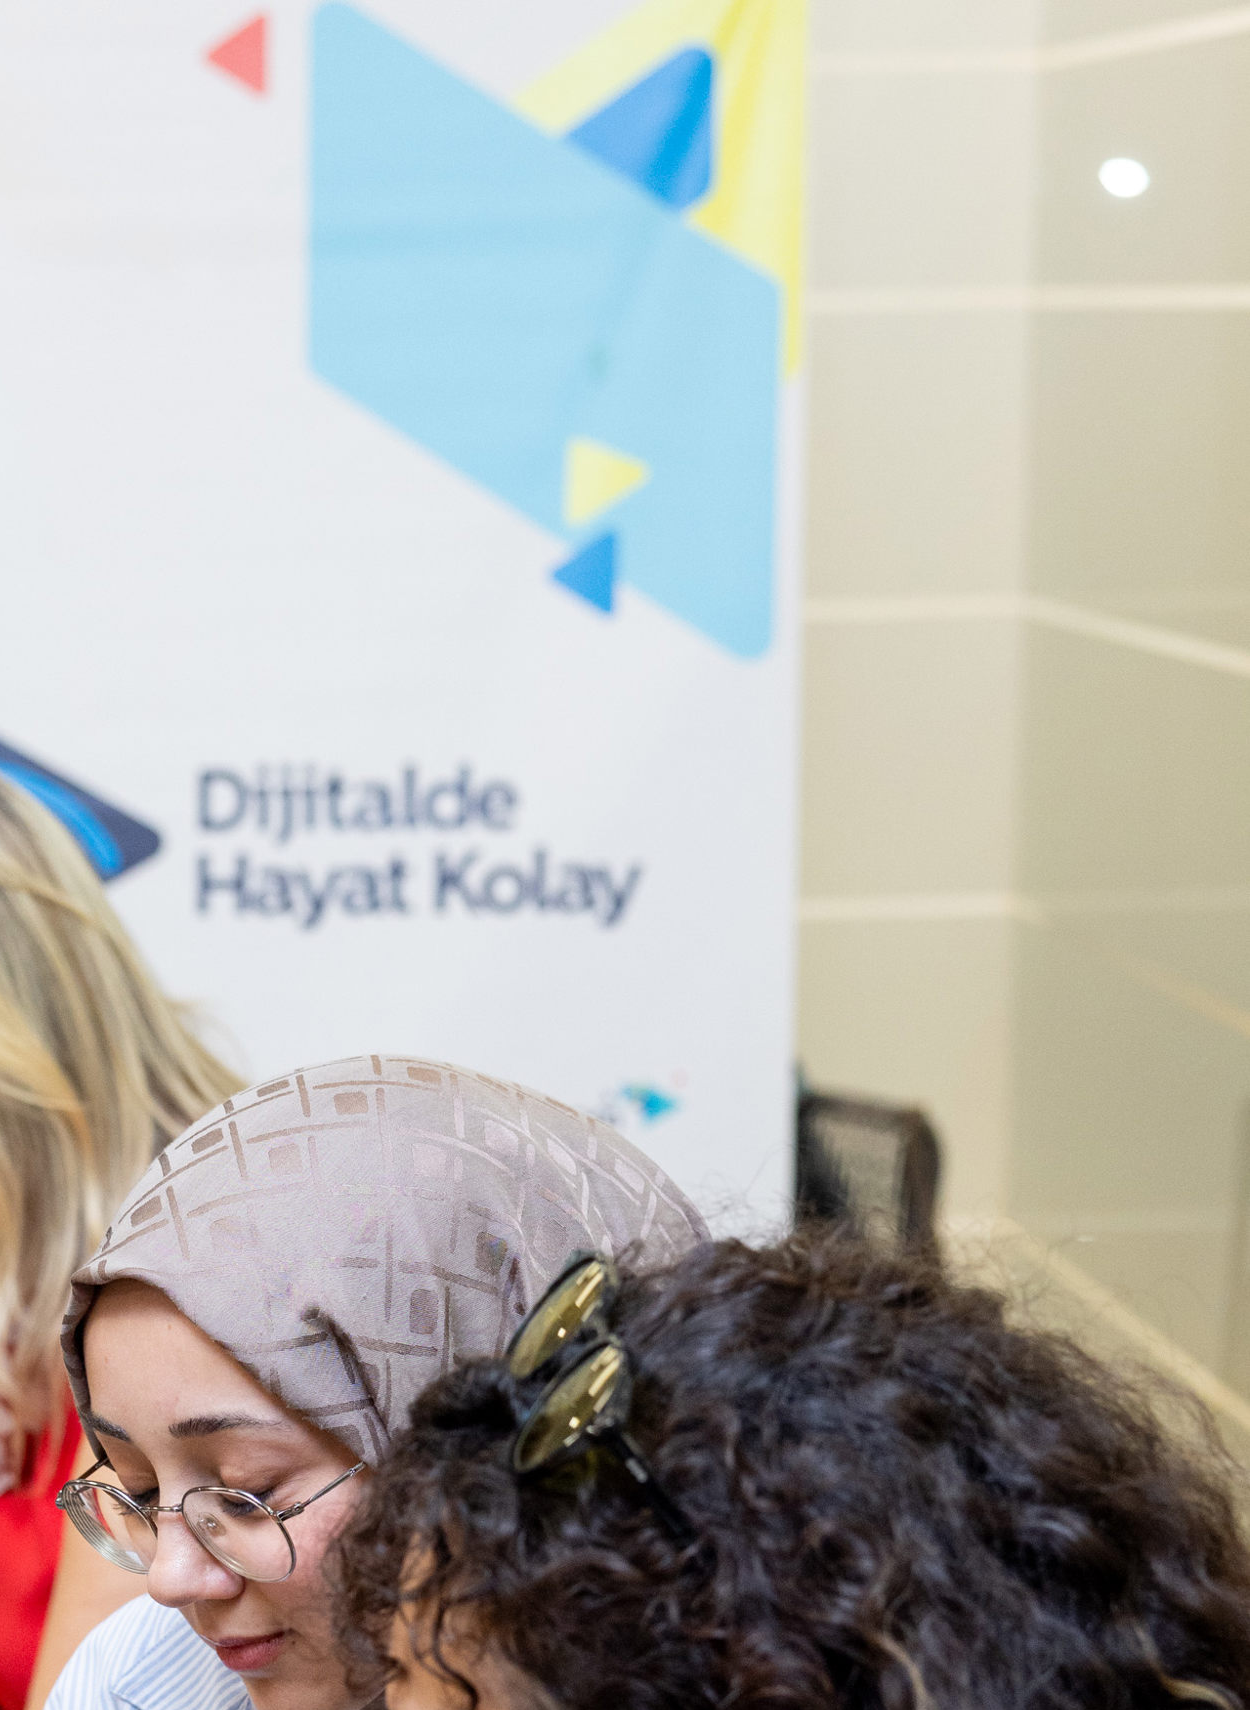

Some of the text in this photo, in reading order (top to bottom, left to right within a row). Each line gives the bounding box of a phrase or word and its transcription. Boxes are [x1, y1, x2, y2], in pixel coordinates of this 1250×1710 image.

[197, 764, 518, 843] Dijitalde
[196, 847, 642, 930] Hayat Kolay
